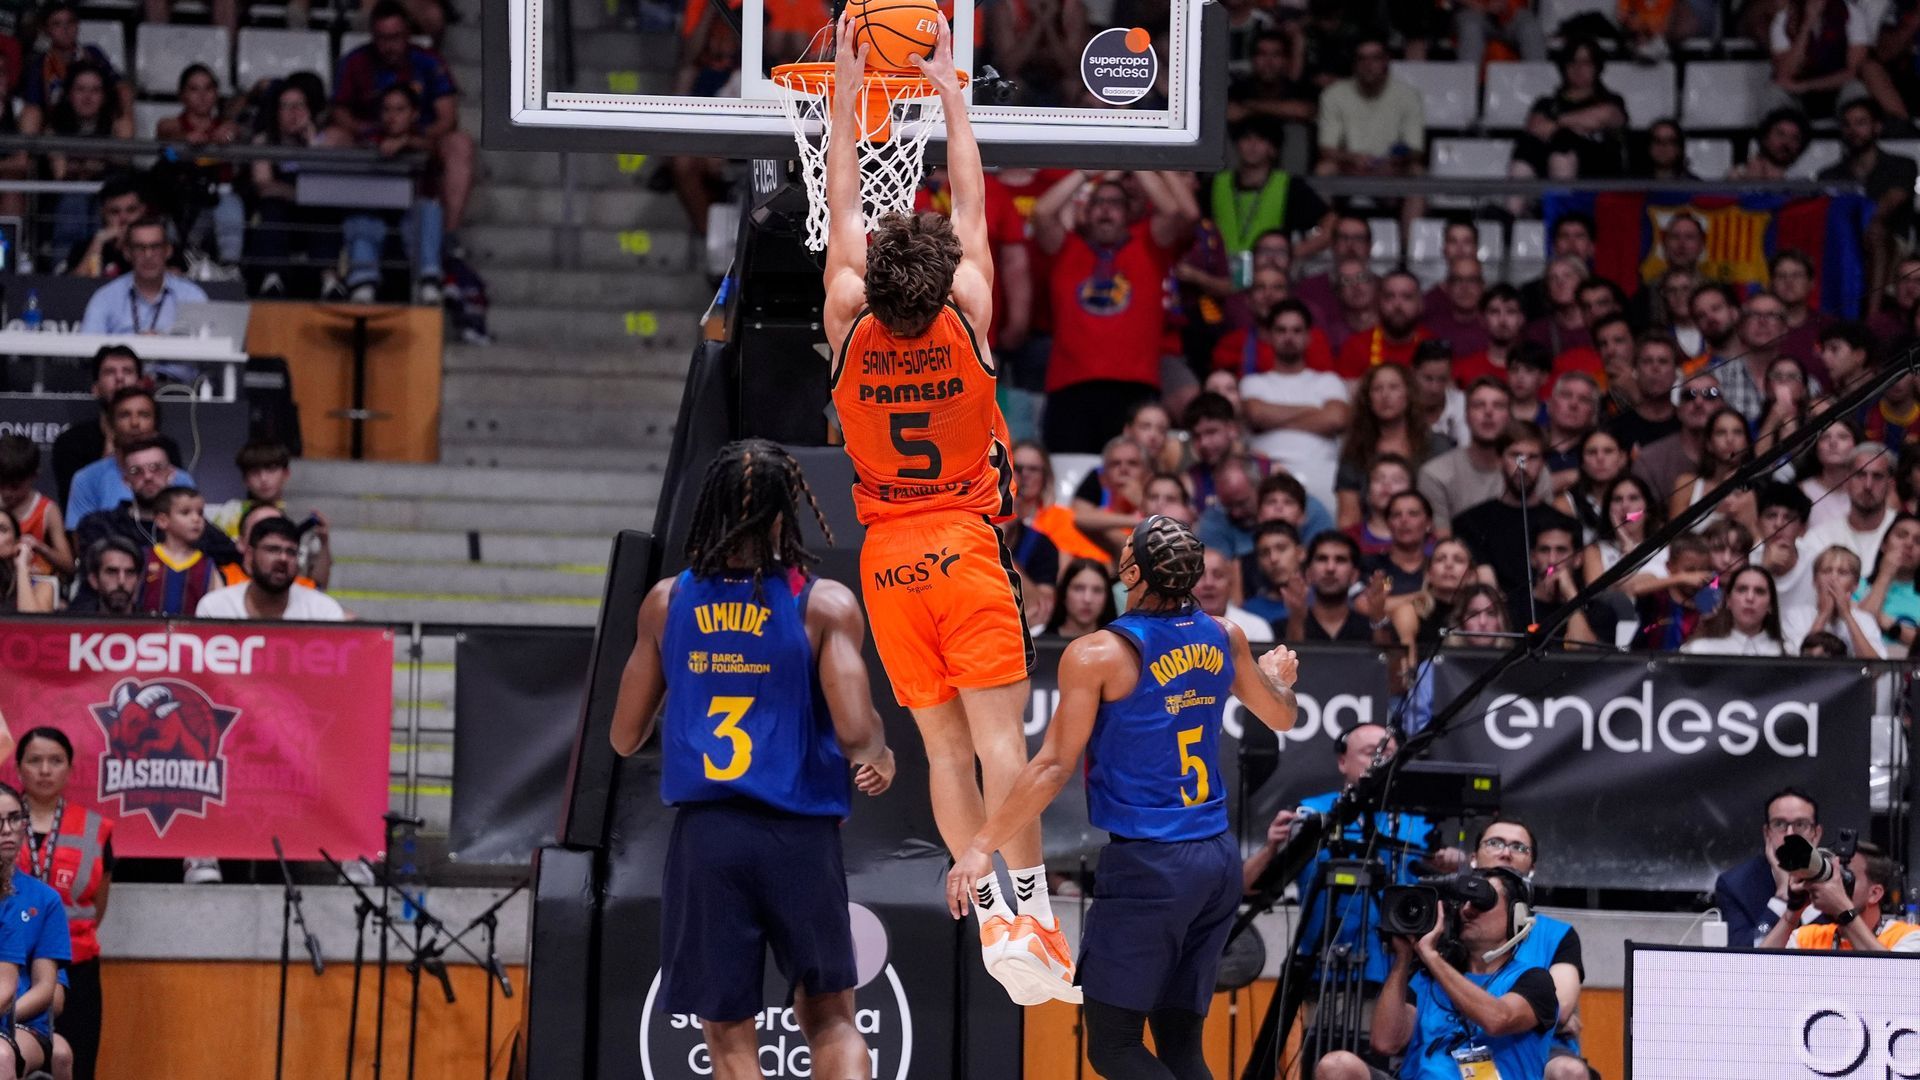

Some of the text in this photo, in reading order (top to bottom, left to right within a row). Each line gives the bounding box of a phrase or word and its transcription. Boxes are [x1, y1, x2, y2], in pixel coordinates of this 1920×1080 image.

[1089, 56, 1149, 67] supercopa
[1094, 65, 1149, 78] endesa
[625, 311, 658, 336] 15
[862, 340, 952, 376] SAINT-SUPÉRY
[859, 377, 964, 404] PAMESA
[889, 411, 942, 480] 5
[874, 562, 930, 591] MGS
[694, 602, 772, 637] UMUDE
[68, 632, 266, 675] kosner
[711, 652, 744, 664] BARÇA
[711, 663, 771, 674] FOUNDATION
[1149, 643, 1224, 687] ROBINSON
[1484, 680, 1818, 758] endesa
[703, 695, 755, 781] 3
[105, 758, 220, 794] BASHONIA
[1177, 724, 1210, 808] 5
